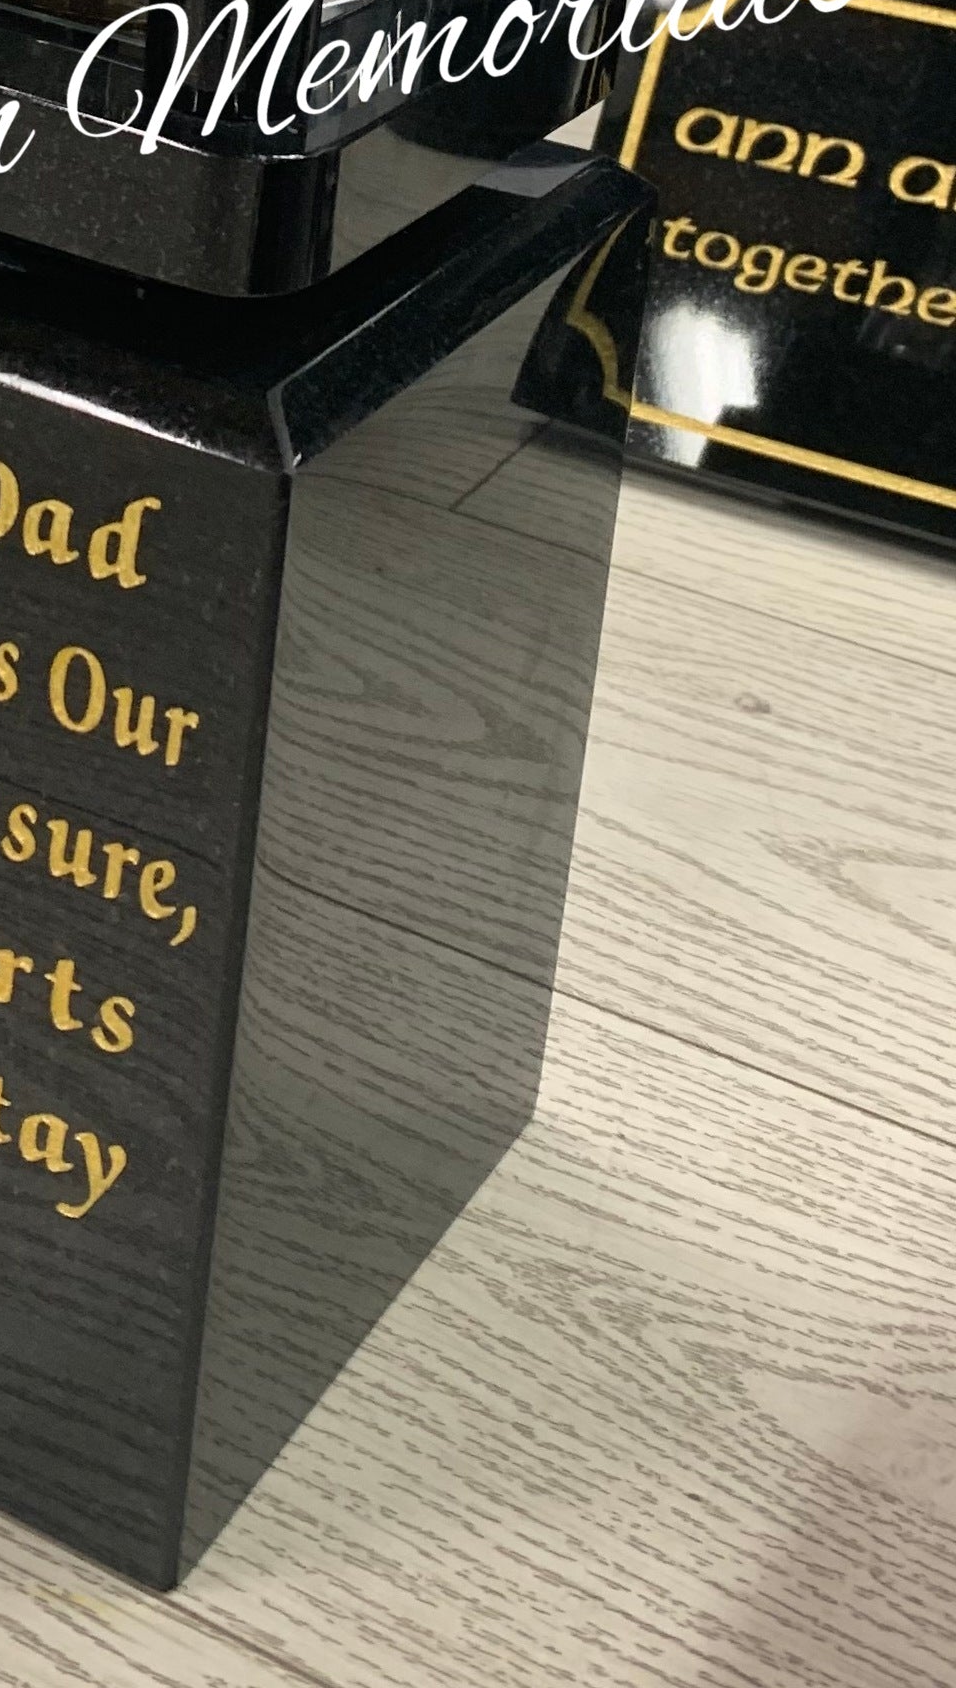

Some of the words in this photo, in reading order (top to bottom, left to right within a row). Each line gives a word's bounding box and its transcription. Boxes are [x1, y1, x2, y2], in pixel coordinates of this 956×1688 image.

[673, 106, 867, 189] ann
[887, 155, 956, 211] a
[662, 215, 956, 327] togethe
[47, 644, 201, 768] Our
